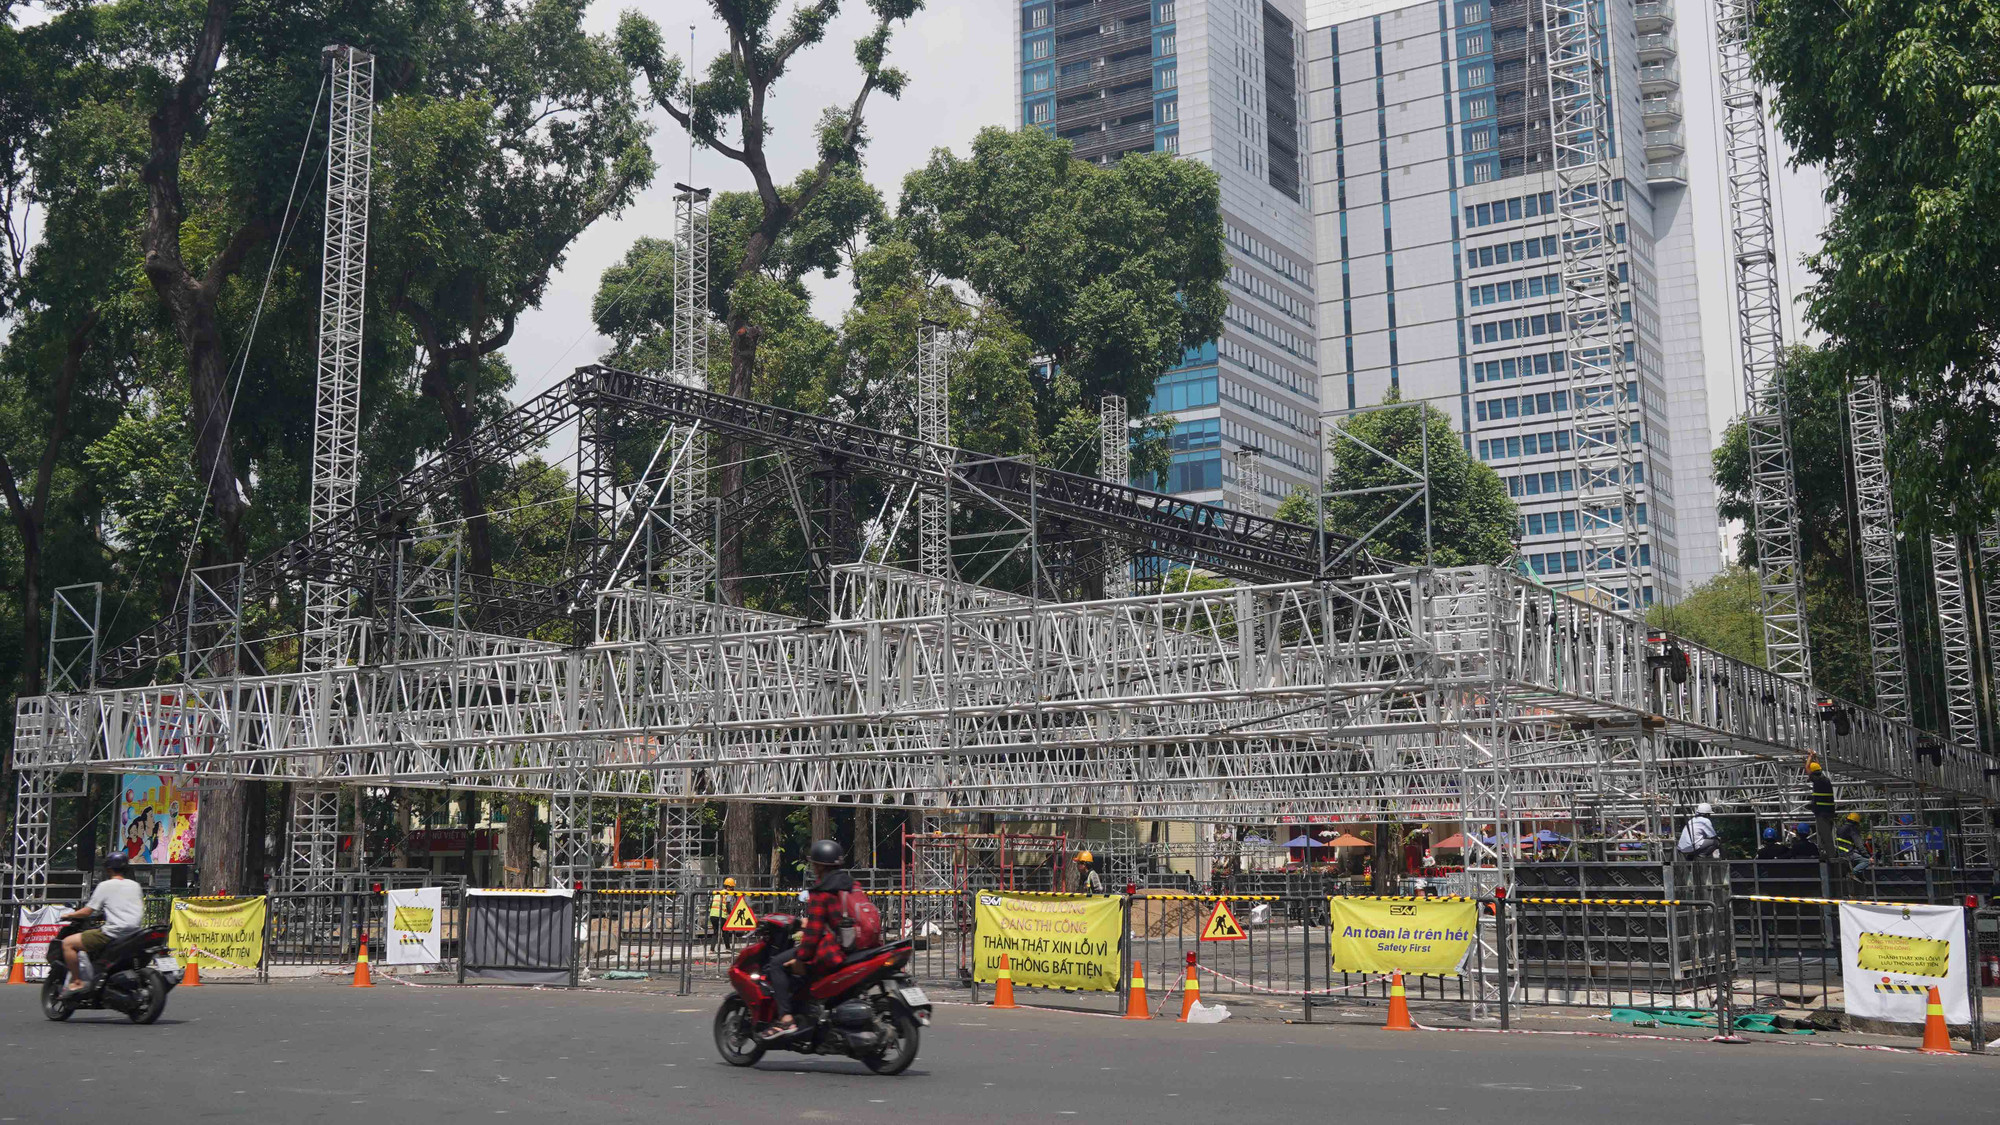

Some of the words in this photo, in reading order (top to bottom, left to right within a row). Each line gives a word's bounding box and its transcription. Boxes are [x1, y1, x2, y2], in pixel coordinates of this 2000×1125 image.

[1000, 918, 1032, 932] ĐANG
[1035, 920, 1052, 932] THI
[1054, 918, 1088, 934] CÔNG
[1342, 926, 1362, 938] An
[1364, 927, 1395, 939] toàn
[1398, 927, 1411, 940] là
[1413, 928, 1442, 940] trên
[1445, 927, 1469, 941] hết
[221, 932, 234, 943] XIN
[983, 934, 1019, 950] THÀNH
[1021, 937, 1050, 955] THẬT
[1052, 940, 1072, 954] XIN
[1075, 938, 1094, 956] LỖI
[1096, 940, 1108, 956] VÌ
[199, 947, 220, 958] HÔNG
[1377, 942, 1407, 953] Safety
[1409, 944, 1431, 952] First
[987, 955, 1001, 969] LƯ
[1010, 957, 1049, 973] THÔNG
[1052, 957, 1074, 975] BẤT
[1076, 961, 1103, 979] TIỆN
